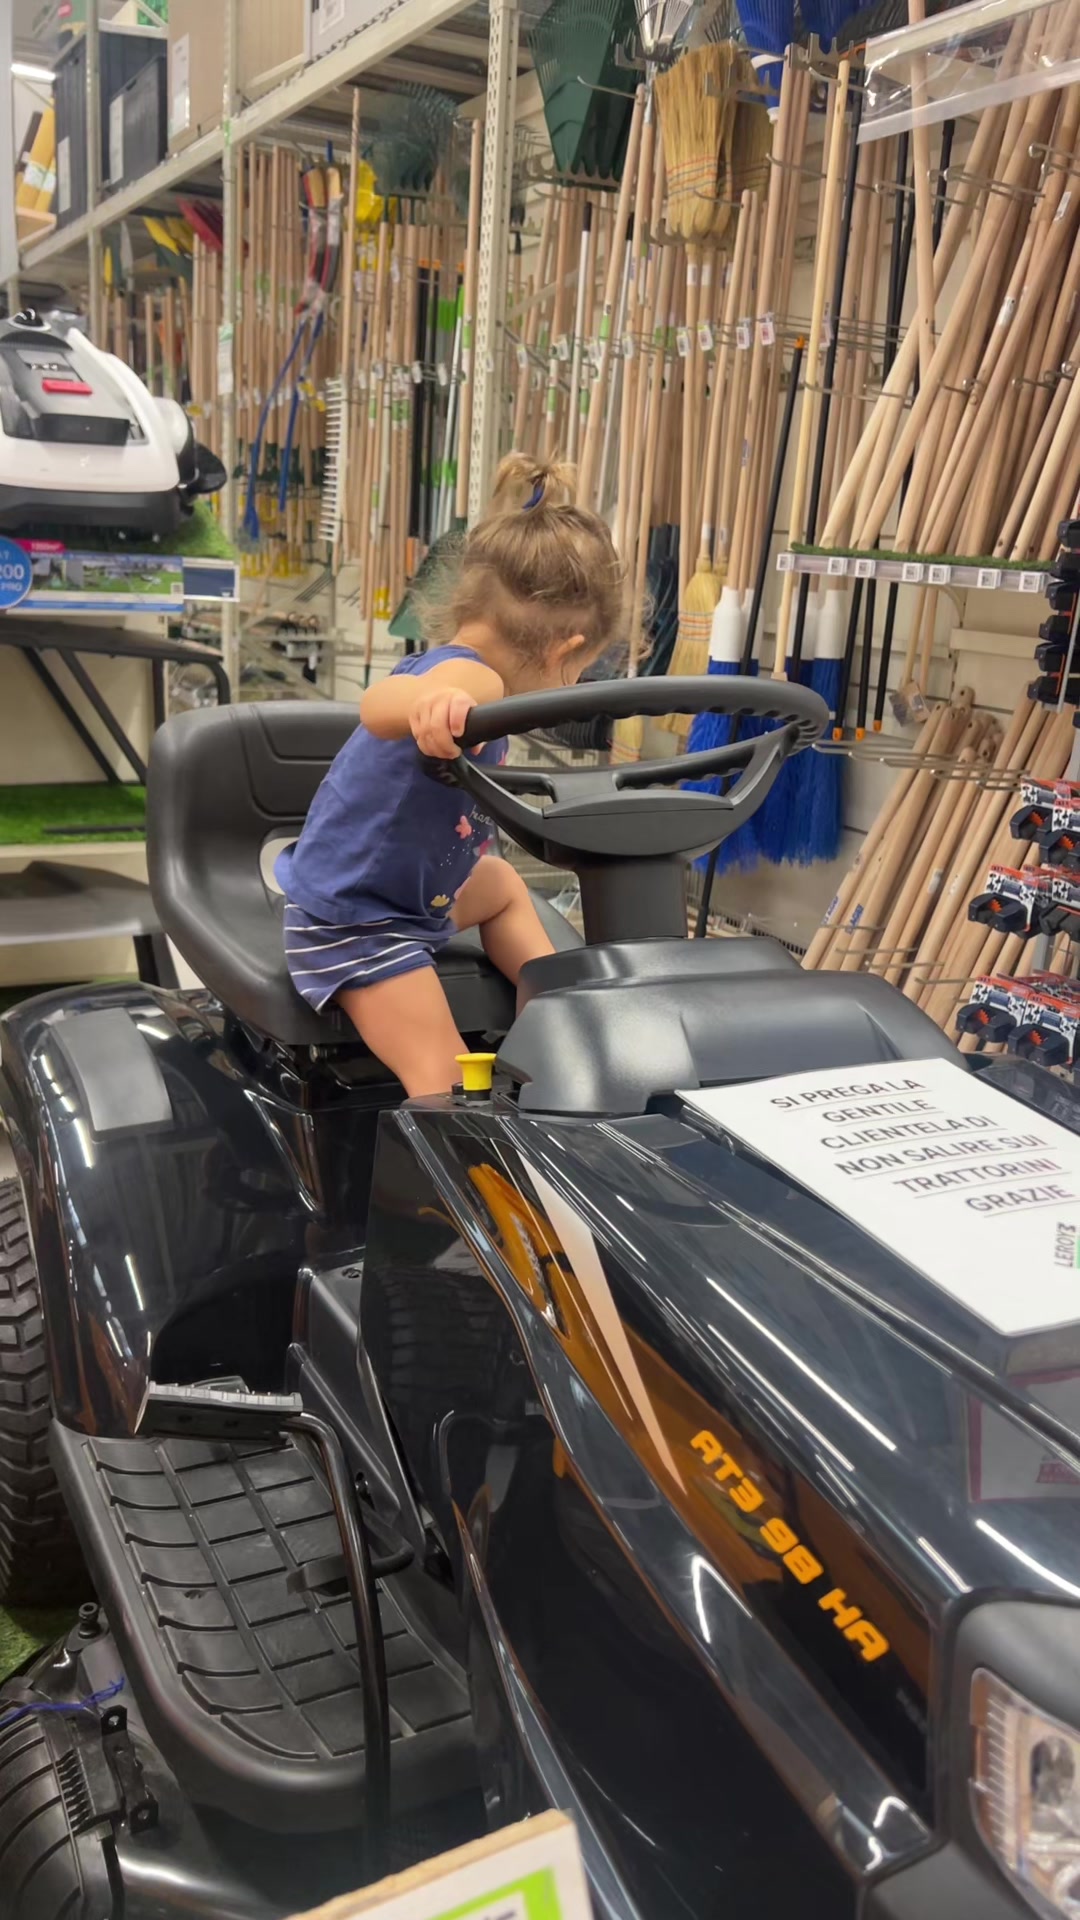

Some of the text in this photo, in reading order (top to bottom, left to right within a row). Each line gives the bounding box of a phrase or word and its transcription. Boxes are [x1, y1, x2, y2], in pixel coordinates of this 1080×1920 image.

[770, 1079, 926, 1108] SI PREGA LA
[822, 1099, 936, 1123] GENTILE
[820, 1115, 999, 1149] CLIENTELA DI
[834, 1134, 1048, 1175] NON SALIRE SUI
[892, 1158, 1063, 1193] TRATTORINI
[965, 1184, 1075, 1212] GRAZIE
[1054, 1230, 1075, 1267] LEROY
[690, 1429, 889, 1662] AT3 98 HA
